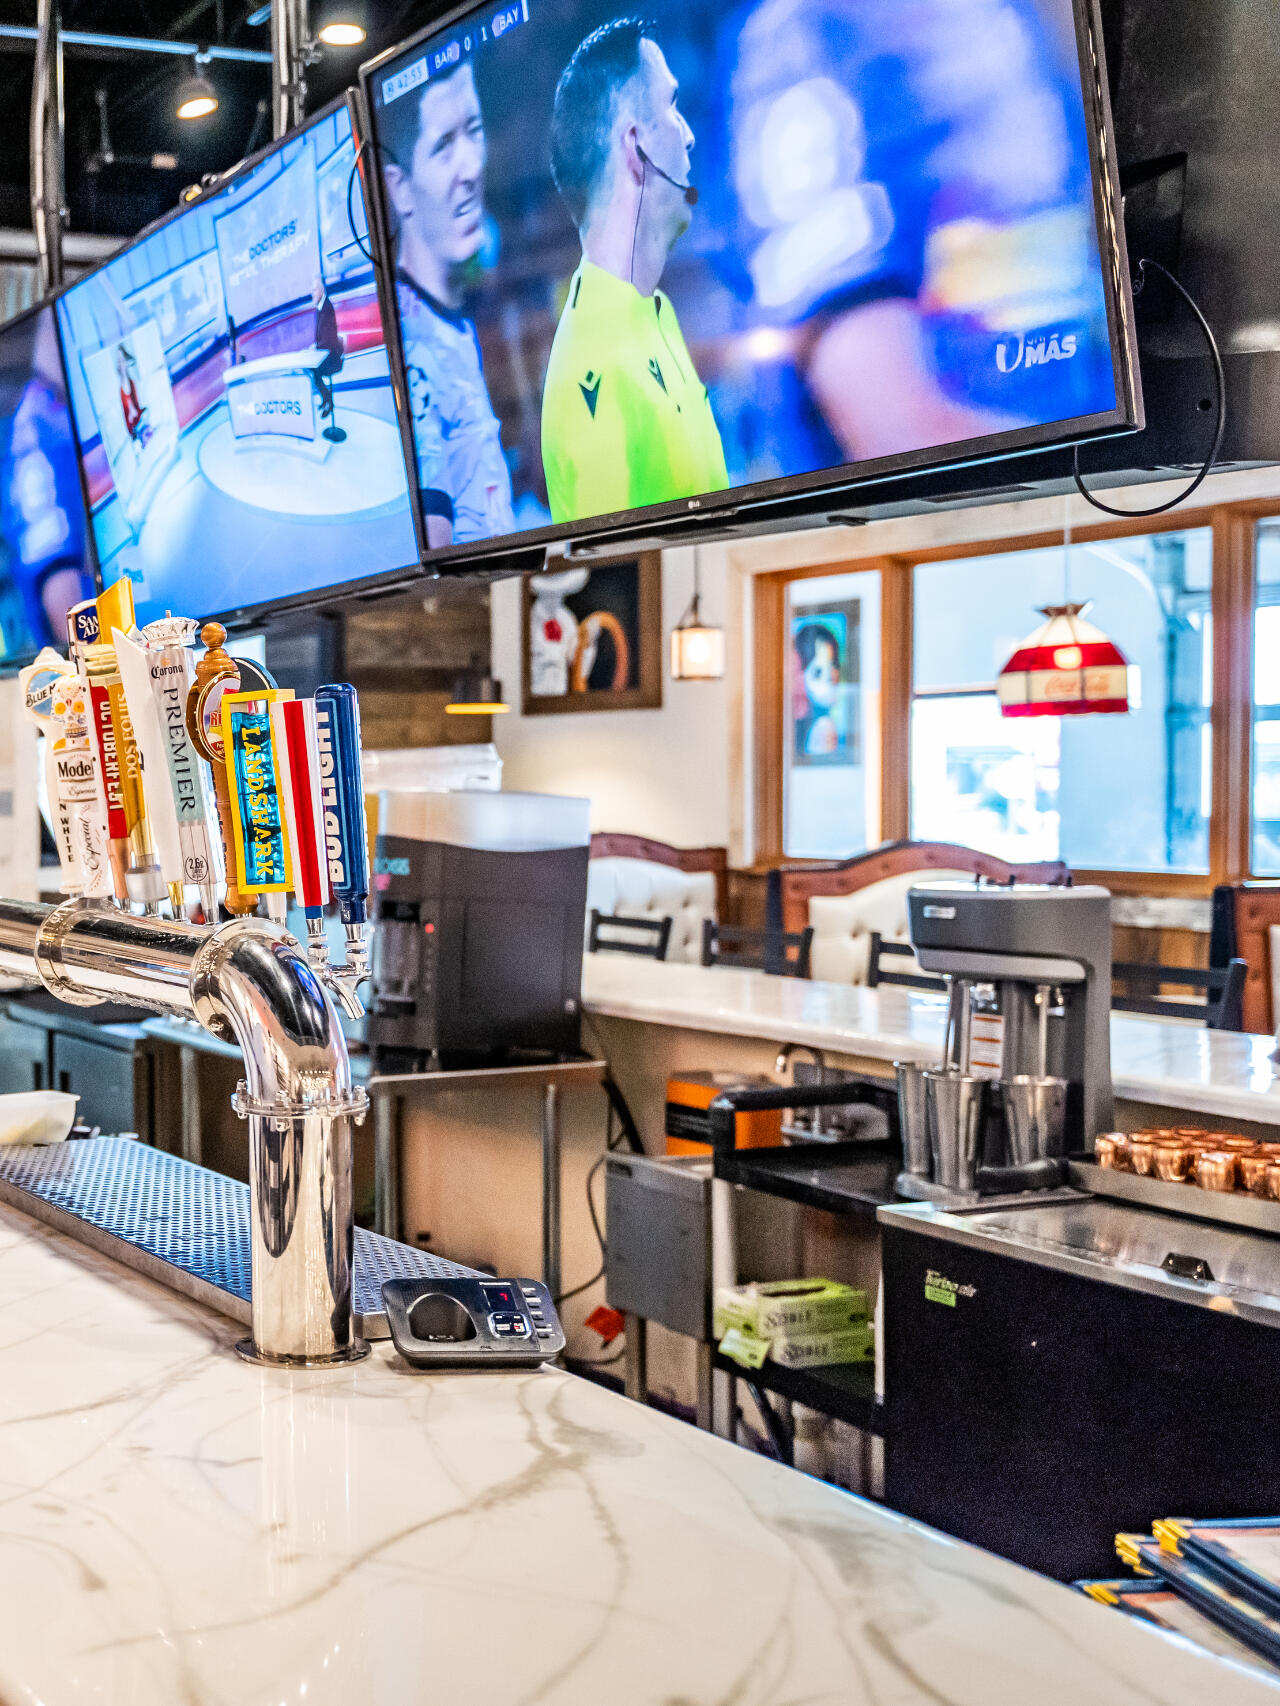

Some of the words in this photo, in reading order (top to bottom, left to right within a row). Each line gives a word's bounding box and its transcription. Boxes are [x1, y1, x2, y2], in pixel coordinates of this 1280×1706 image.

[435, 48, 453, 69] BAR
[464, 36, 471, 51] 0
[499, 8, 519, 30] BAY
[151, 664, 184, 680] Corona
[25, 689, 47, 708] BLUE
[58, 760, 95, 778] Model
[124, 746, 138, 779] DOS
[163, 687, 196, 812] PREMIER
[241, 727, 274, 876] LANDSHARK
[61, 818, 74, 862] WHITE
[324, 811, 345, 883] BUD
